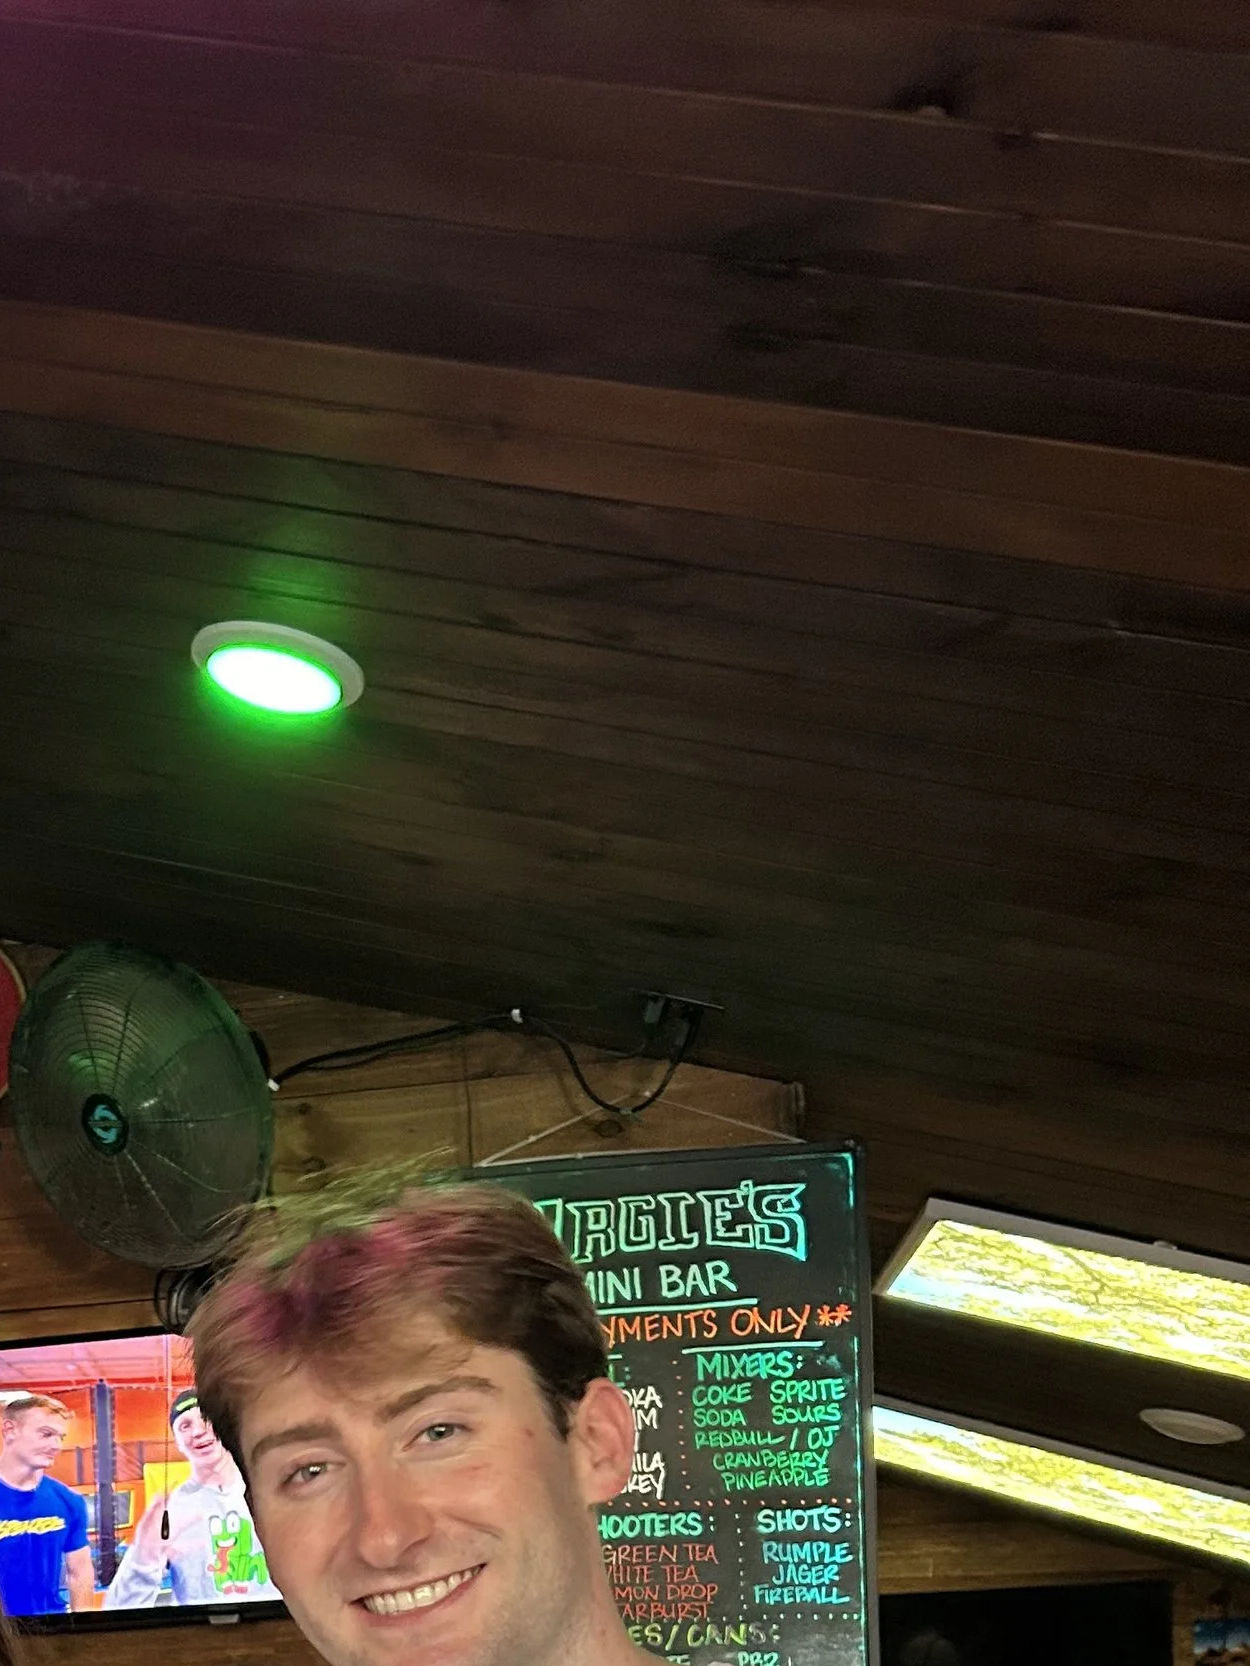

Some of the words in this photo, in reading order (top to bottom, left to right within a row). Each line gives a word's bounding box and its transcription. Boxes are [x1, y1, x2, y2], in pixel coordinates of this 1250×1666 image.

[659, 1260, 738, 1298] BAR
[696, 1350, 804, 1381] MIXERS:
[692, 1383, 752, 1407] COKE
[770, 1378, 847, 1403] SPRITE
[693, 1408, 747, 1428] SODA
[772, 1403, 843, 1426] SOURS
[694, 1430, 785, 1449] REDBULL
[807, 1425, 840, 1449] OJ
[712, 1449, 830, 1473] CRANBERRY
[721, 1469, 830, 1492] PINEAPPLE
[756, 1505, 853, 1534] SHOTS:
[602, 1543, 679, 1565] GREEN
[682, 1543, 719, 1565] TEA
[762, 1541, 854, 1564] RUMPLE
[661, 1565, 699, 1584] TEA
[612, 1585, 660, 1601] MON
[667, 1583, 718, 1604] DROP
[617, 1601, 714, 1622] ARBURST
